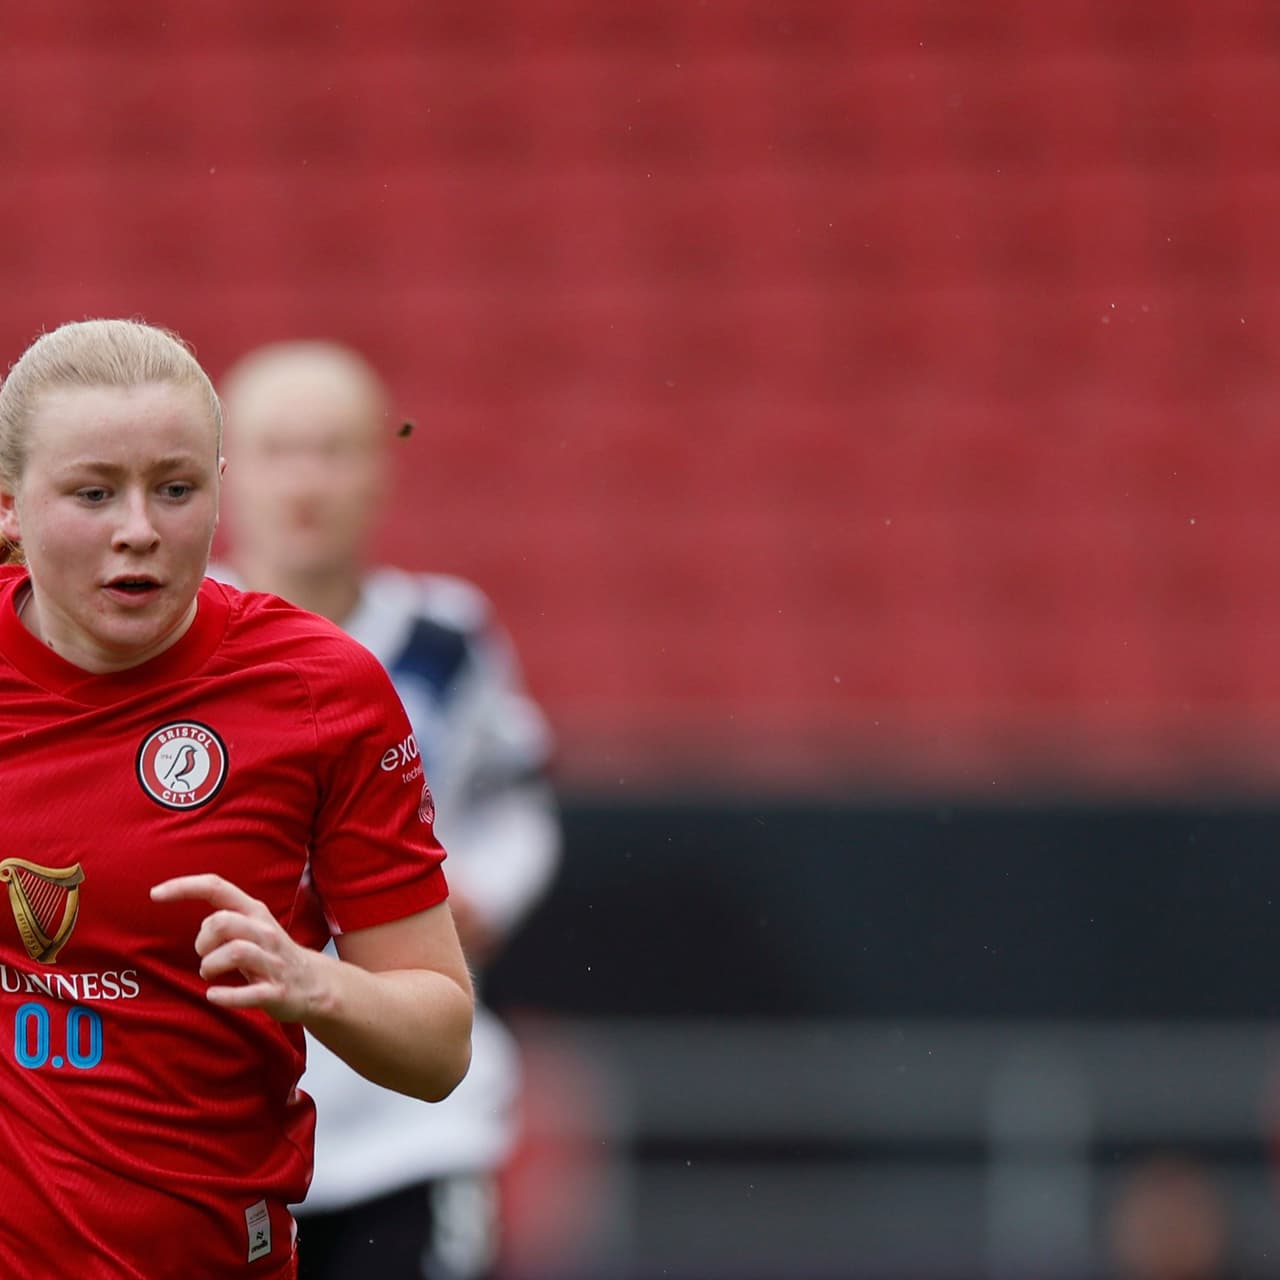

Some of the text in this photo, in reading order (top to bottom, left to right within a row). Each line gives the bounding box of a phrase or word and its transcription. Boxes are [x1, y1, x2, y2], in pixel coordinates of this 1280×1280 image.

[158, 728, 212, 749] BRISTOL
[381, 734, 421, 771] exo
[162, 790, 196, 803] CITY
[14, 1002, 103, 1070] 0.0
